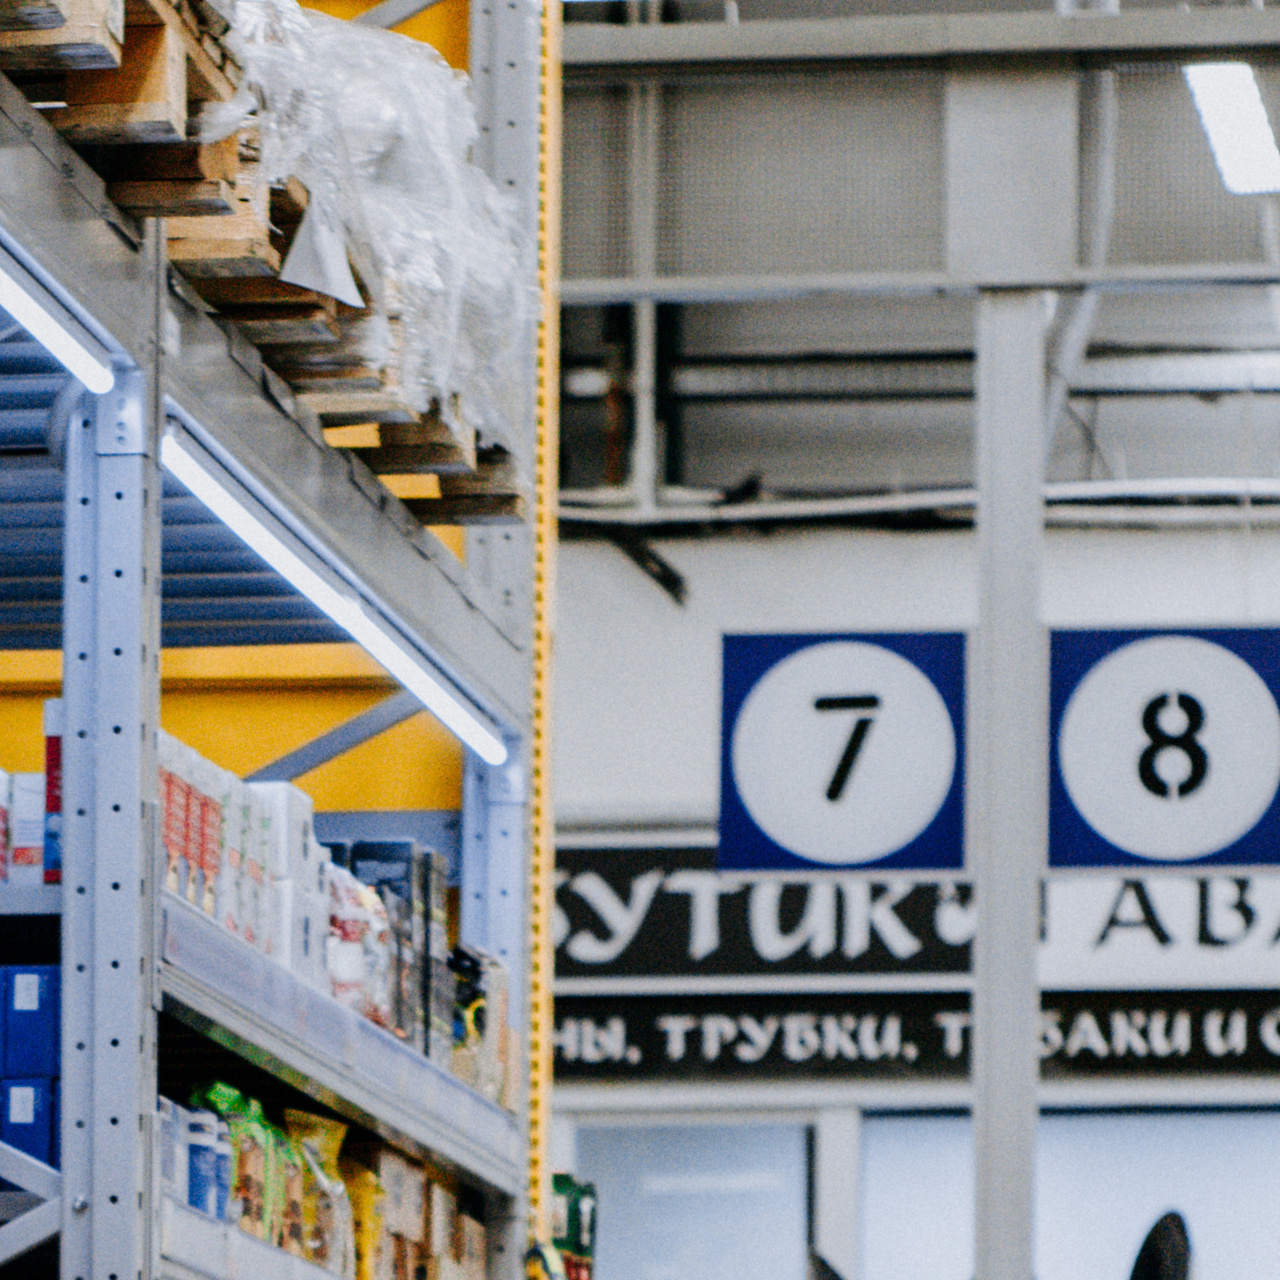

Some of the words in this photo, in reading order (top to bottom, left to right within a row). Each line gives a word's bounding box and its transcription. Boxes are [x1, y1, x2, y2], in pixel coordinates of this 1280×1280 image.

[815, 695, 880, 801] 7
[1137, 692, 1210, 799] 8
[656, 1012, 918, 1064] ТРУБКИ,
[933, 1009, 1190, 1060] ТБАКИ
